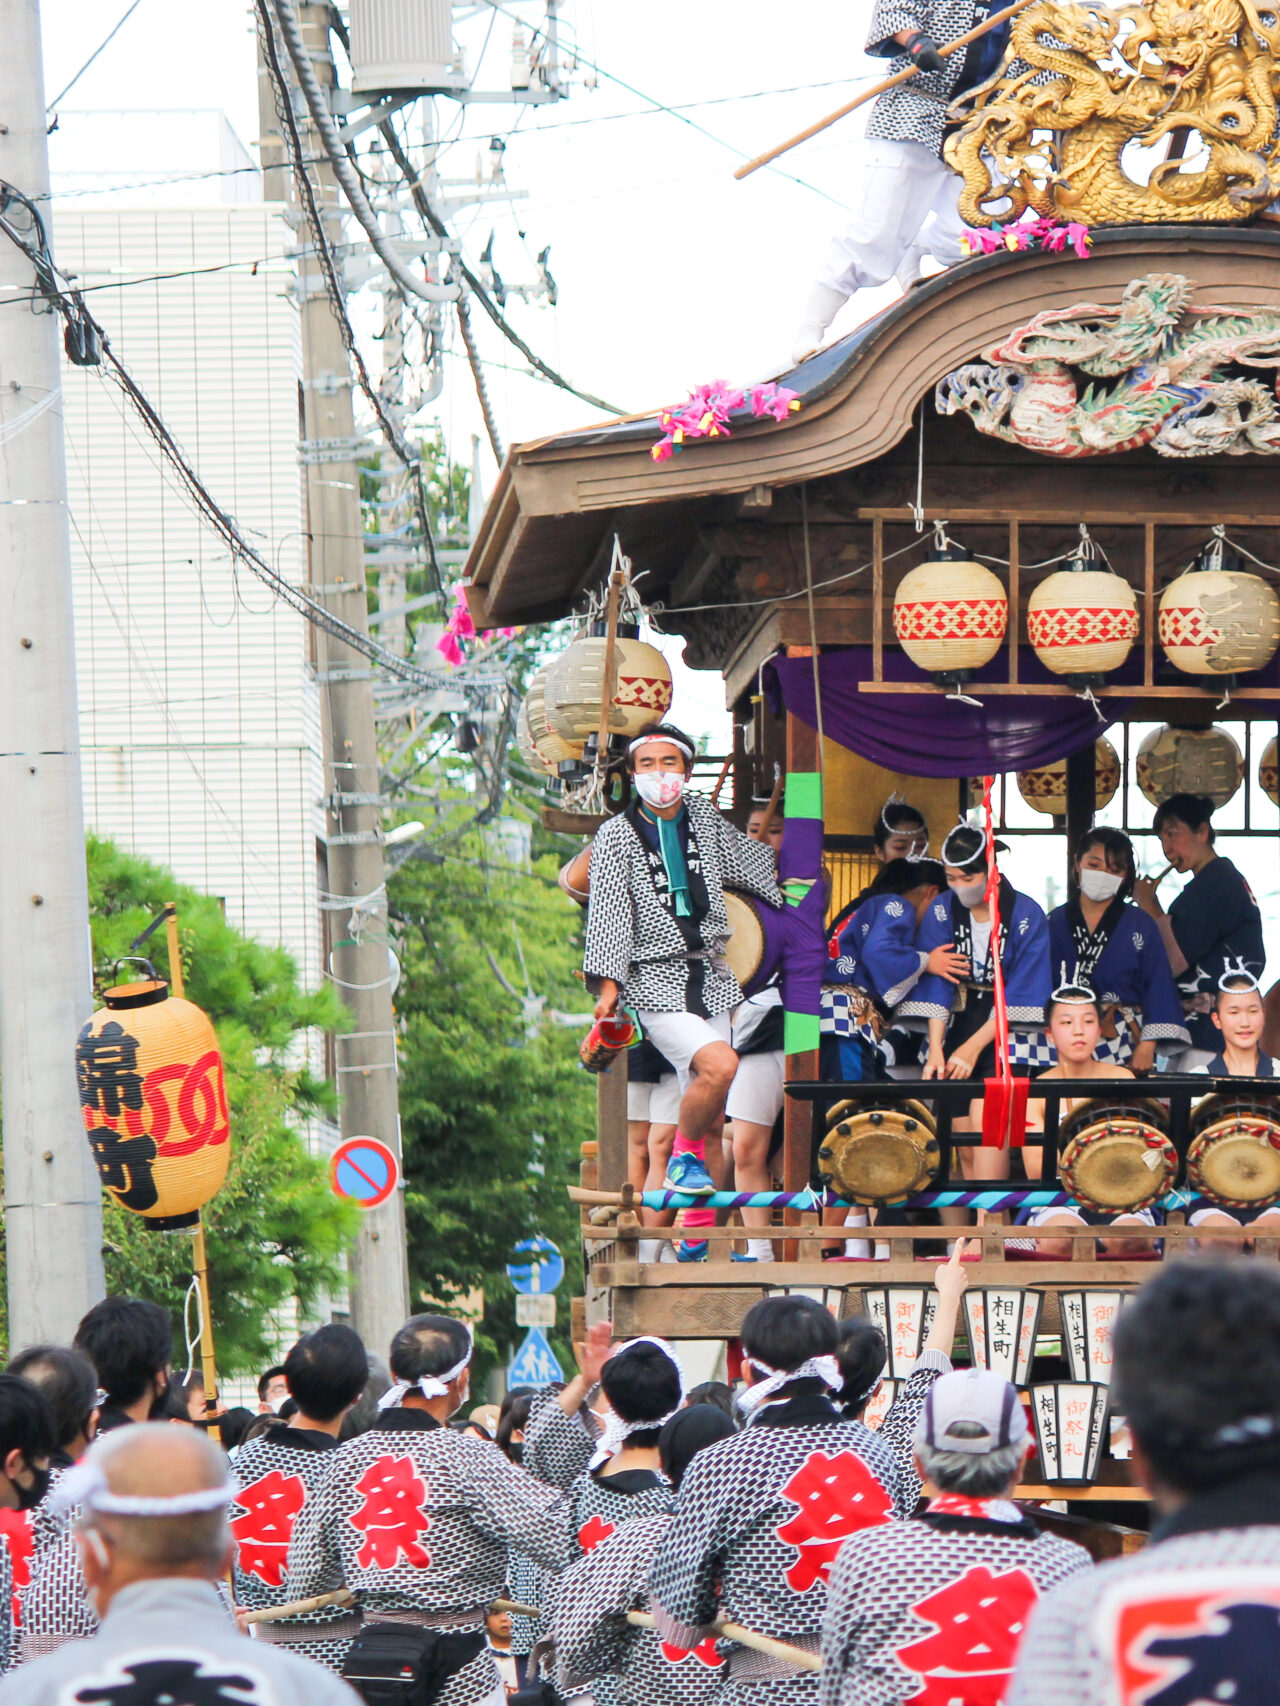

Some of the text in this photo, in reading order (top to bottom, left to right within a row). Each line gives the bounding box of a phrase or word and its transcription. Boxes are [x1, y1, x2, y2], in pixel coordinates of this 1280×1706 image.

[895, 1301, 918, 1359] 御祭礼
[991, 1295, 1015, 1360] 相生町
[1091, 1304, 1115, 1366] 御祭礼
[1064, 1399, 1088, 1457] 御祭礼
